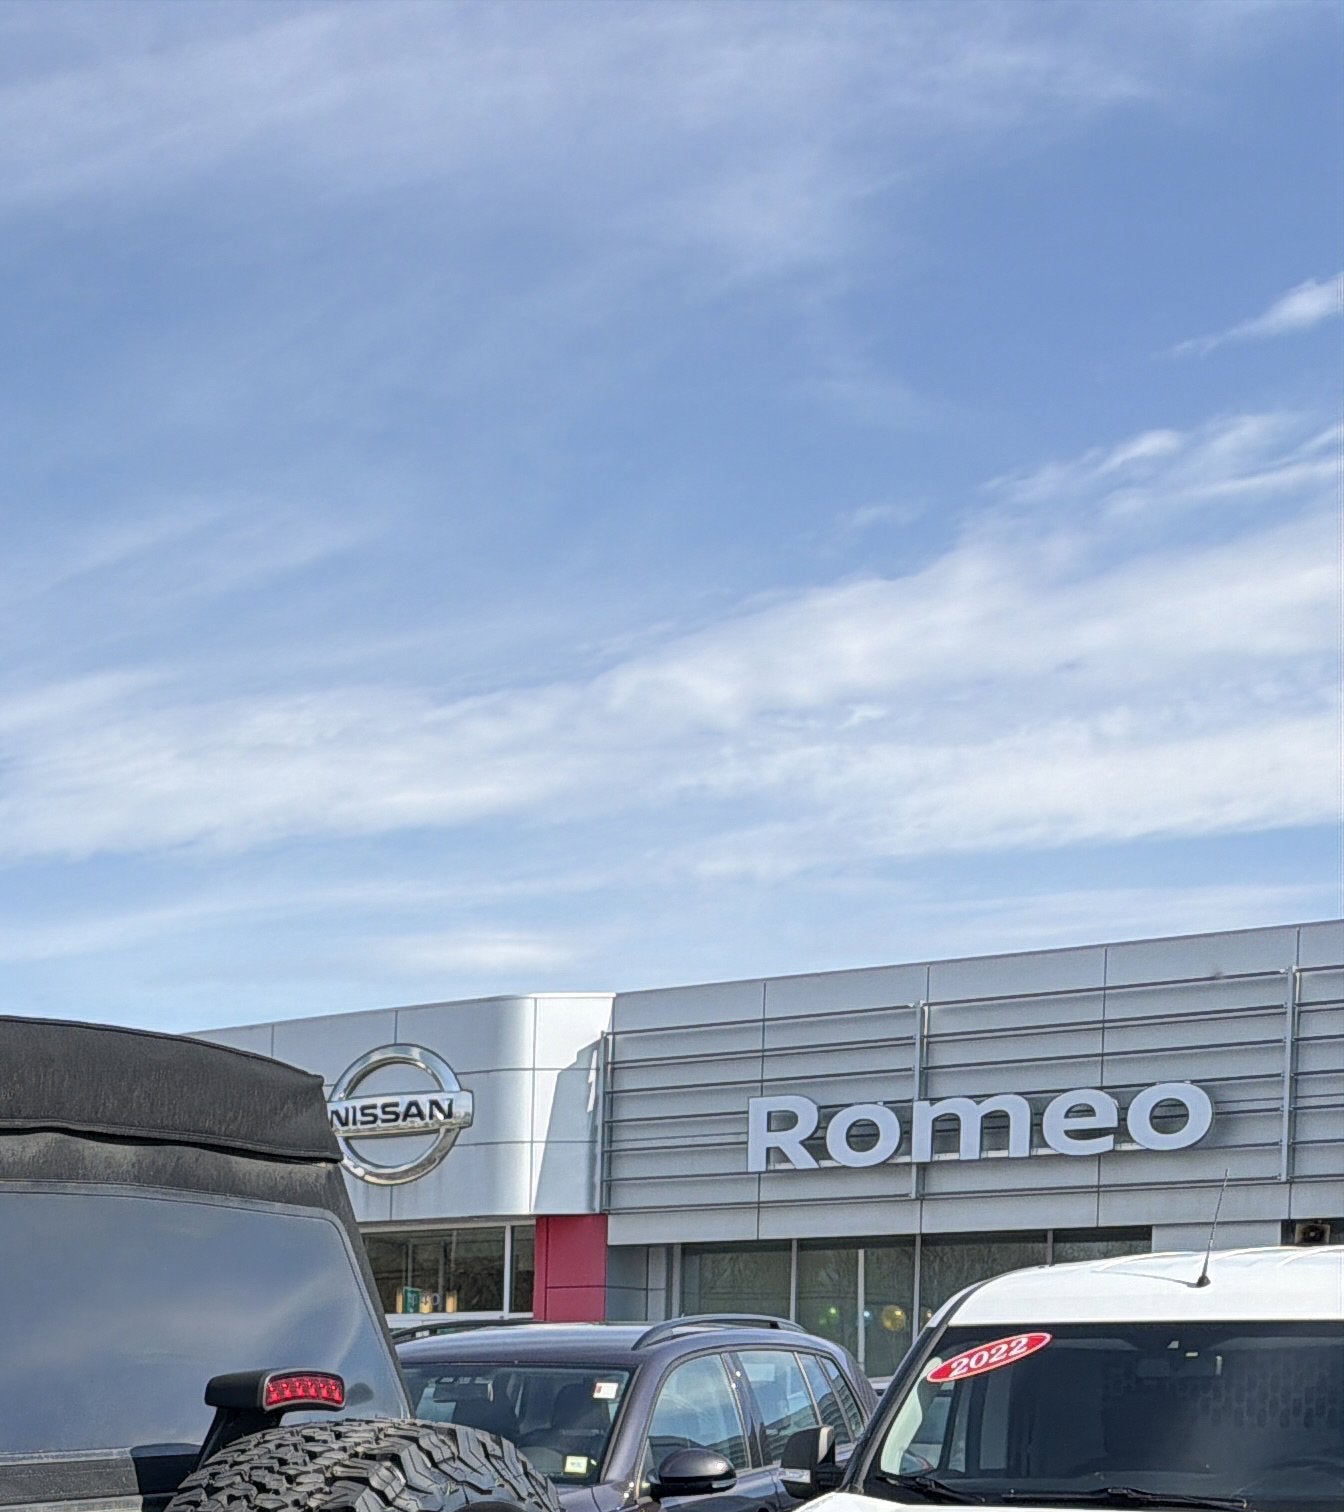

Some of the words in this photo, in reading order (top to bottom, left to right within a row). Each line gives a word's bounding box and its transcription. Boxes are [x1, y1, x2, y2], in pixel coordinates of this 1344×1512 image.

[330, 1098, 454, 1128] NISSAN
[747, 1081, 1212, 1172] Romeo
[949, 1337, 1029, 1378] 2022
